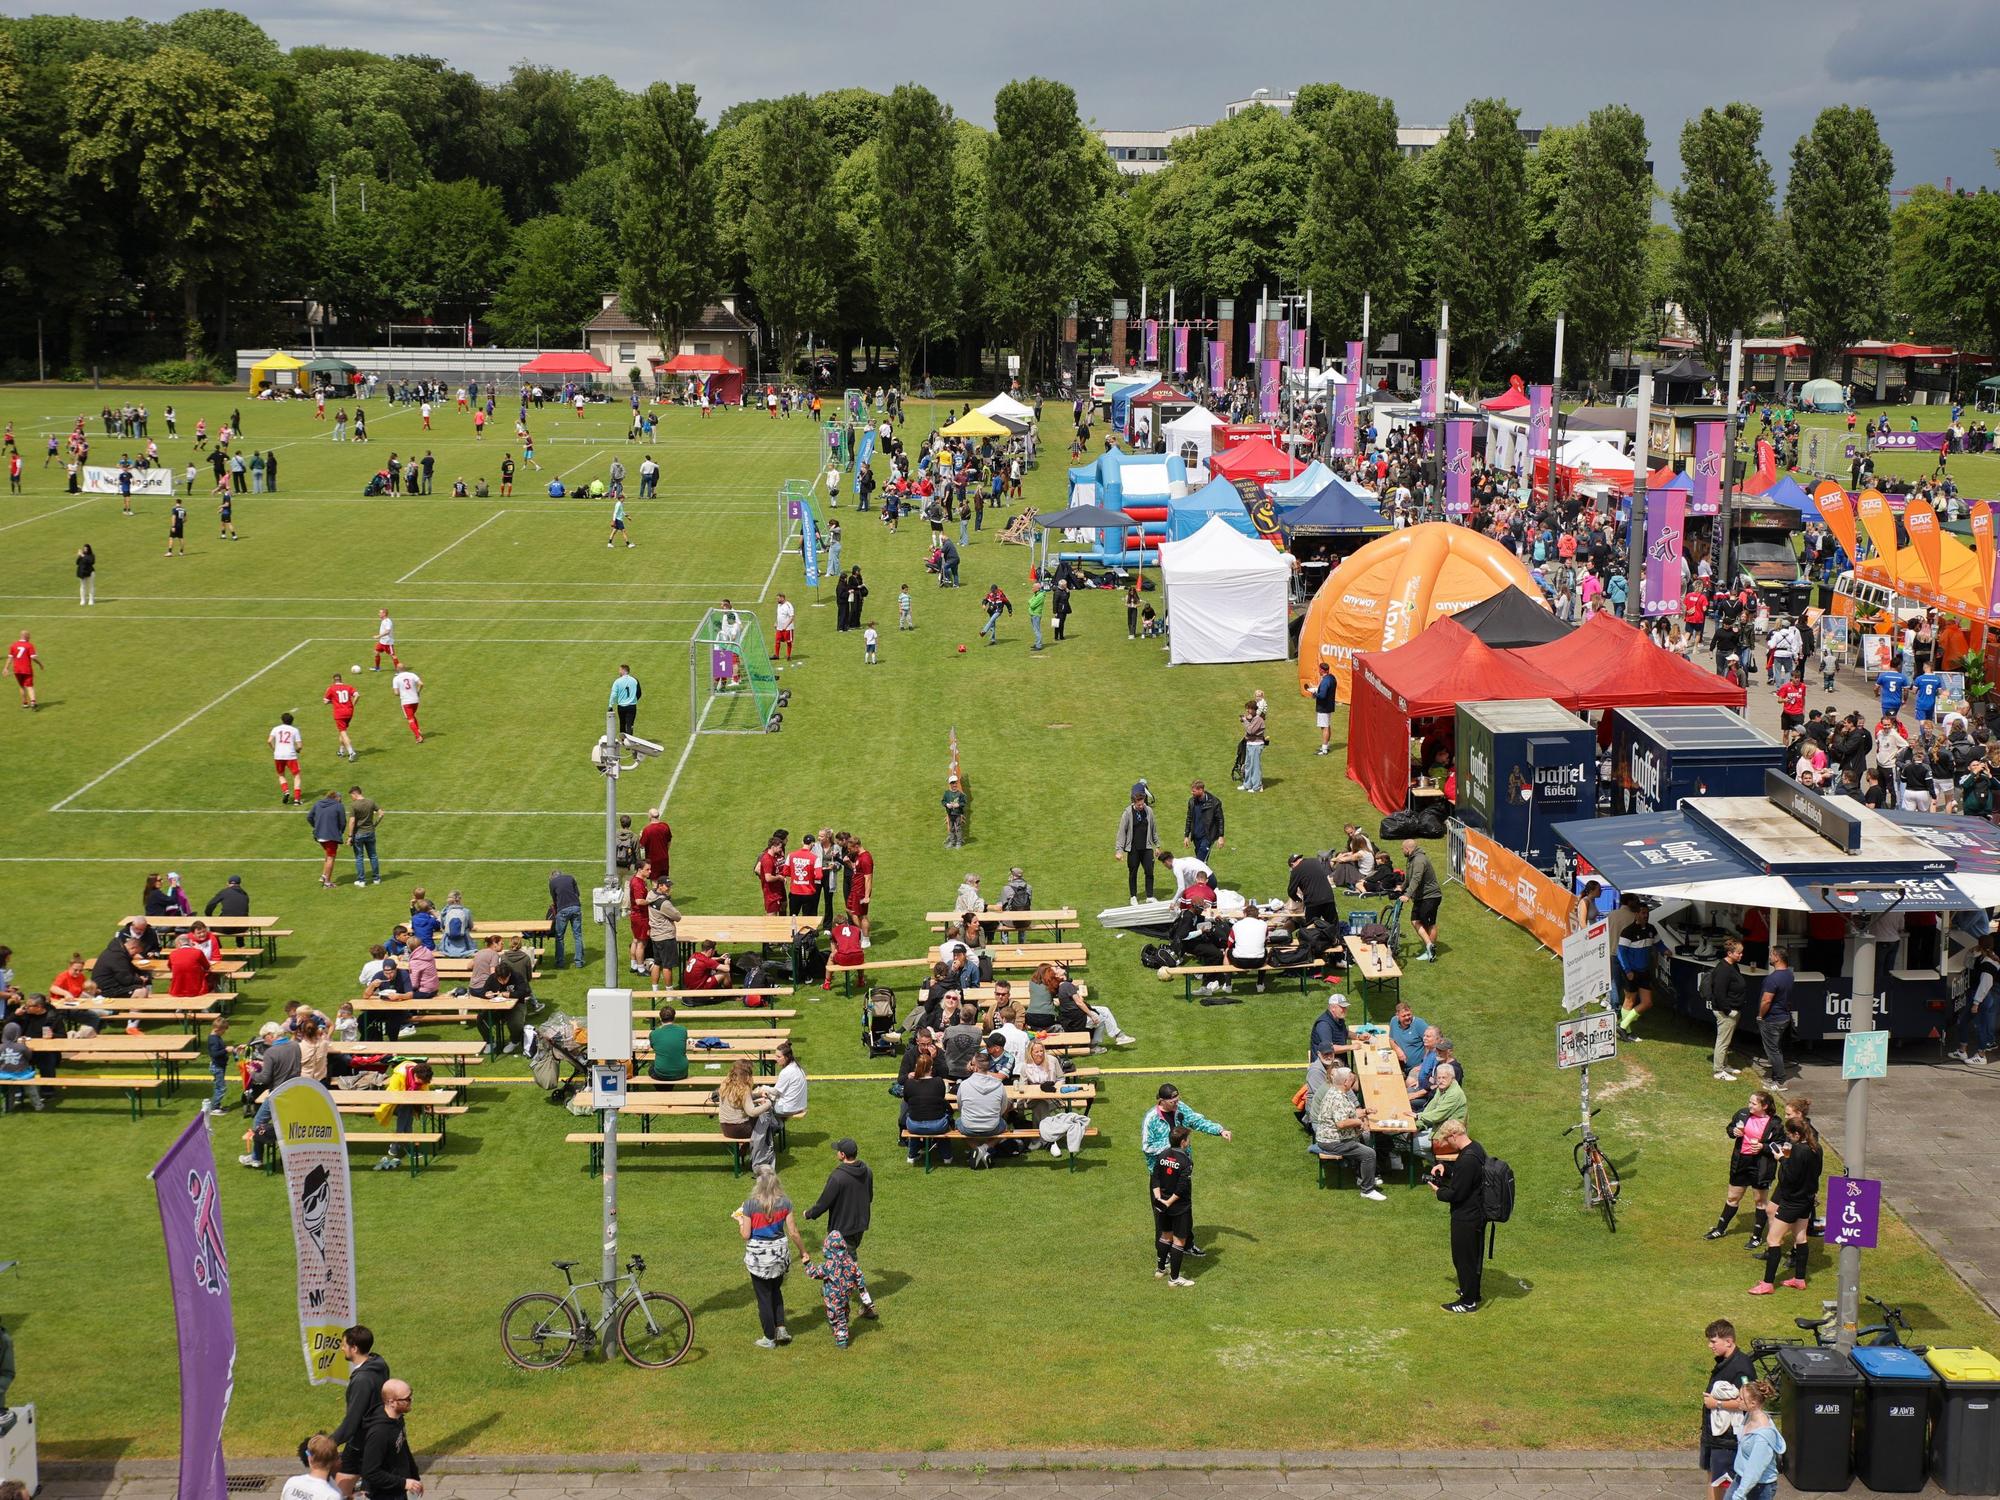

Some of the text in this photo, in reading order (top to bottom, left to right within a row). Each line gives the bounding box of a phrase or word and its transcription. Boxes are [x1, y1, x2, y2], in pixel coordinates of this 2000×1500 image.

[1910, 513, 1934, 528] DAK
[1343, 594, 1377, 607] anyway
[17, 646, 24, 658] 7
[719, 661, 726, 671] 1
[404, 678, 411, 691] 3
[1889, 681, 1896, 692] 5
[1926, 684, 1933, 695] 6
[337, 690, 349, 703] 10
[278, 731, 291, 744] 12
[1544, 785, 1577, 797] Kölsch
[841, 926, 851, 937] 4
[686, 958, 697, 973] 3
[1826, 991, 1889, 1016] Gael
[308, 1125, 333, 1138] cream
[1160, 1158, 1180, 1169] ORTEC
[1841, 1227, 1861, 1237] WC
[1824, 1404, 1840, 1412] AWB
[1899, 1407, 1915, 1415] AWB
